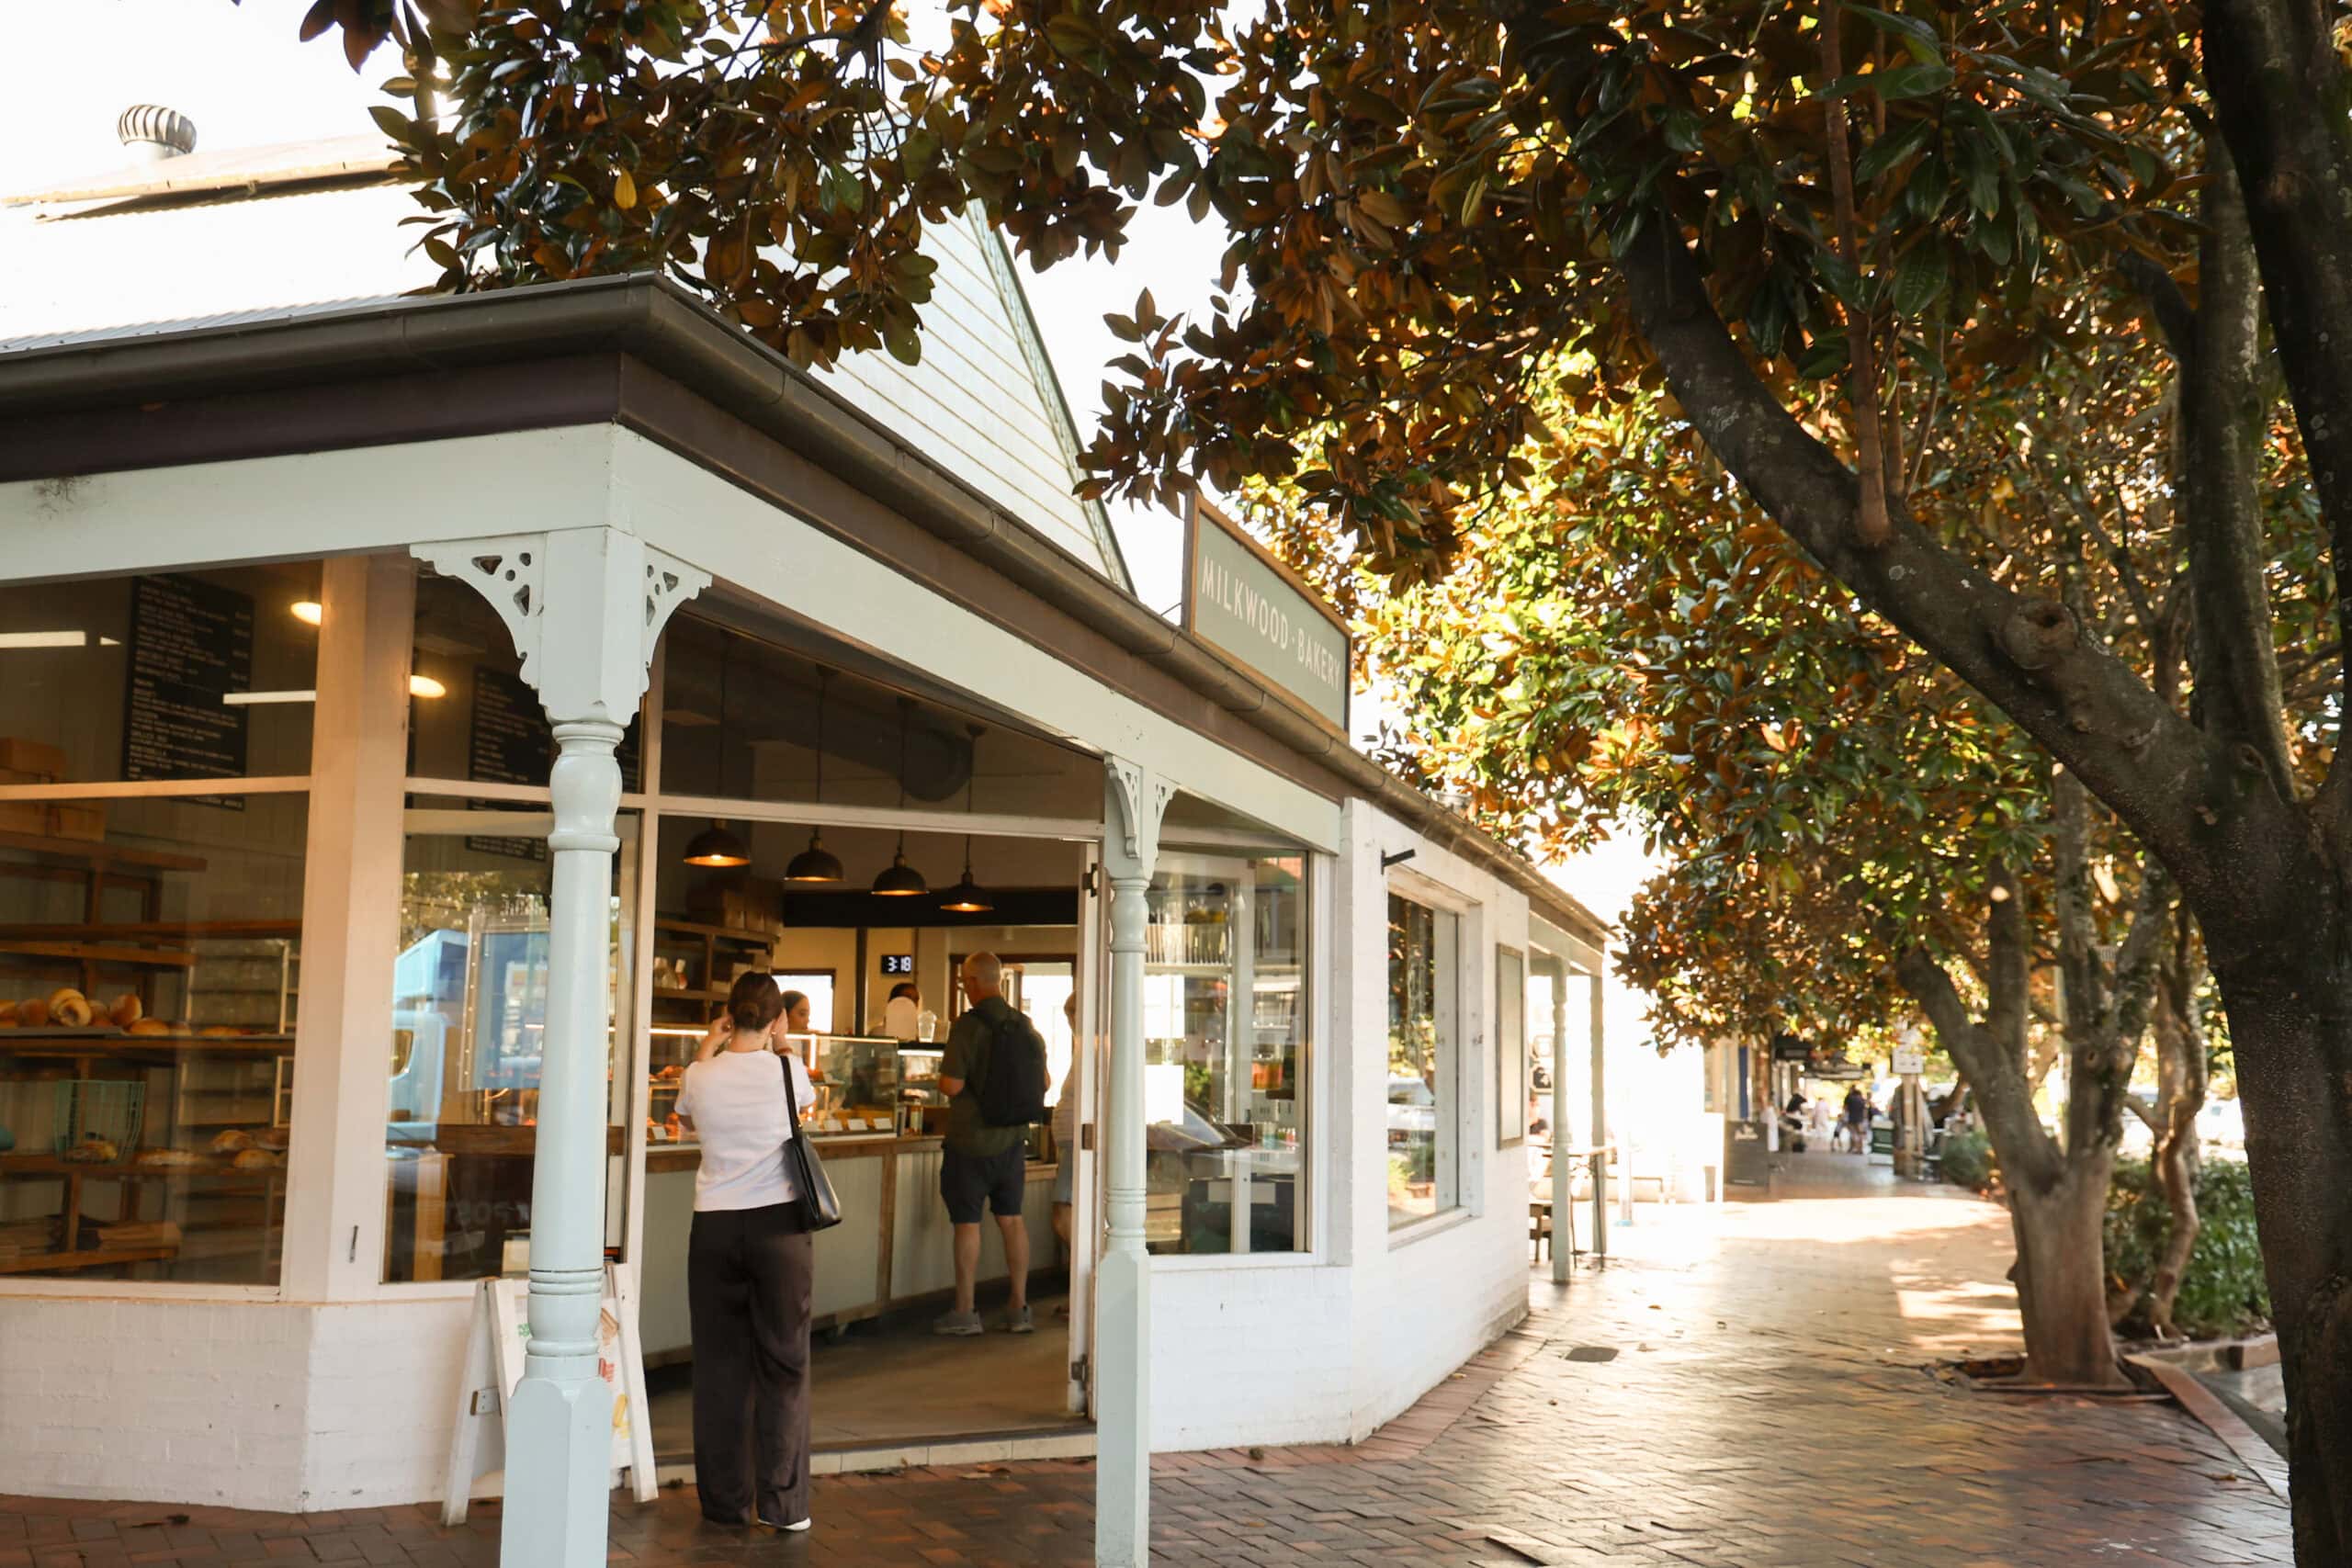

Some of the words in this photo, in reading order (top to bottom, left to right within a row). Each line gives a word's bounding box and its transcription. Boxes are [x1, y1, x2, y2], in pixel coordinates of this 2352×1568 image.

[1202, 555, 1288, 649] MILKWOOD
[1297, 627, 1340, 692] BAKERY
[888, 956, 911, 972] 3:18
